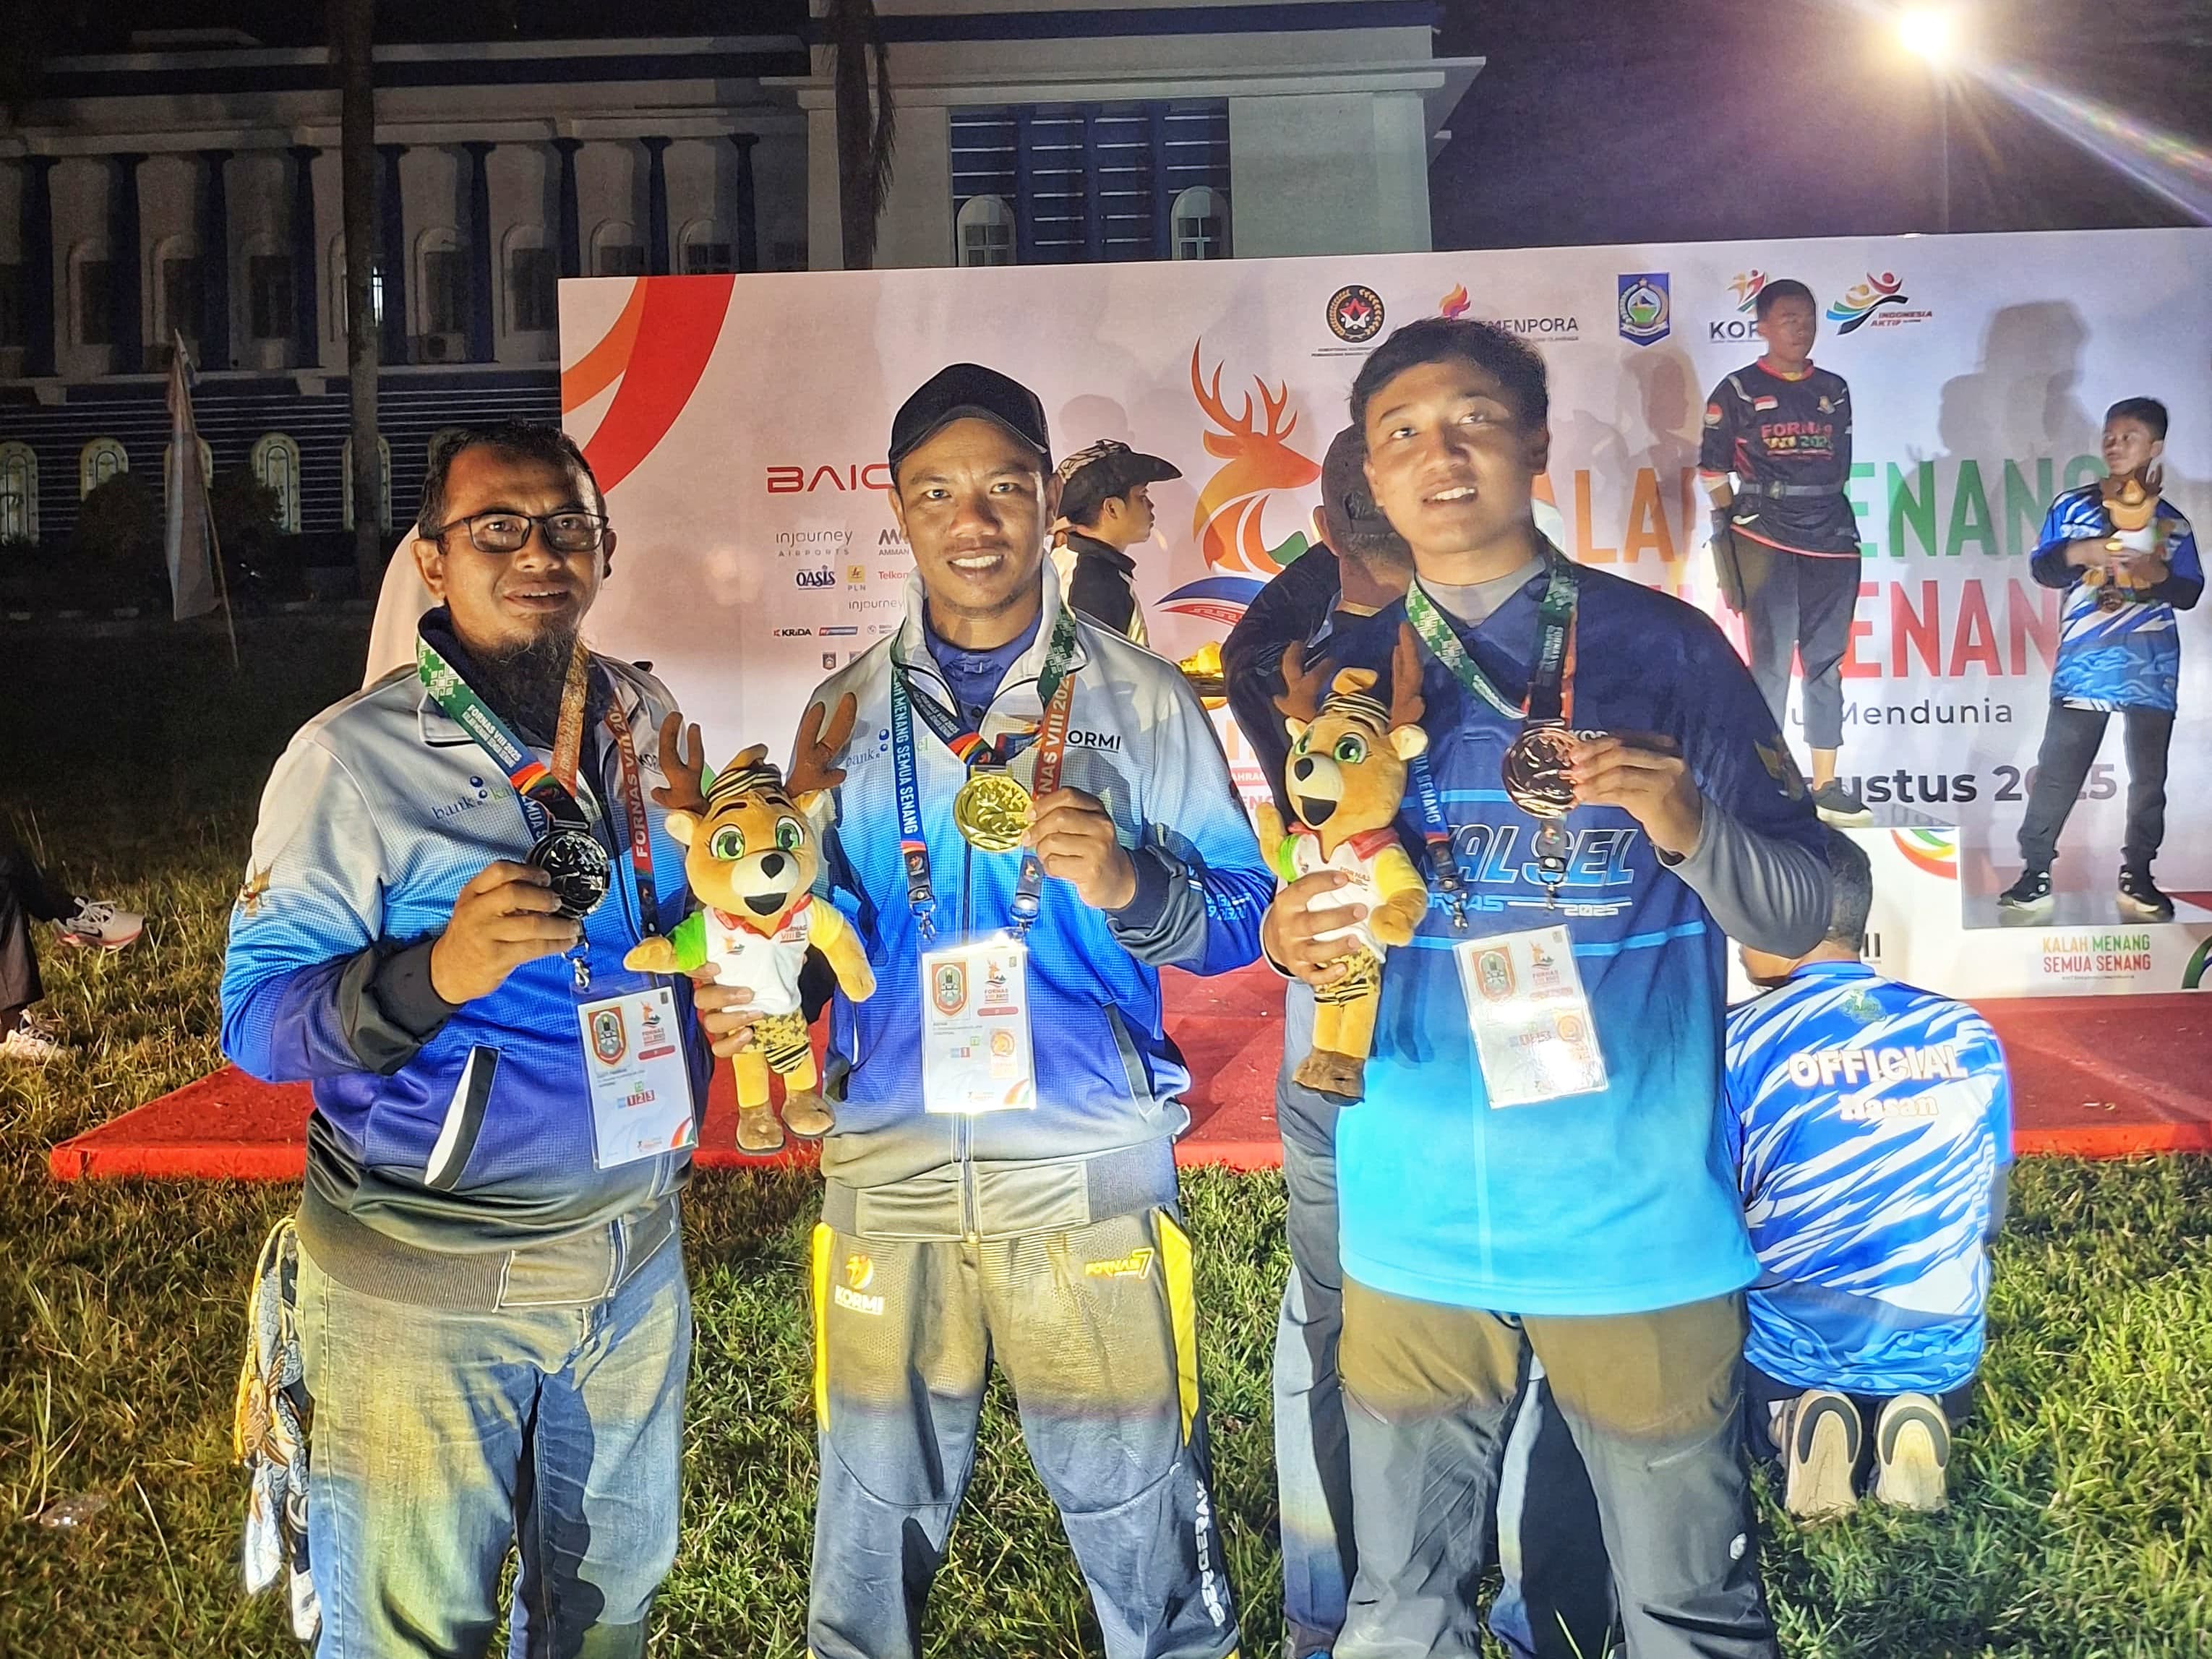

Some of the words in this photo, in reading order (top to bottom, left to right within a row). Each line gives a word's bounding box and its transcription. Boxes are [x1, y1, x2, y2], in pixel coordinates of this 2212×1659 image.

[766, 463, 895, 493] BAIC
[776, 530, 853, 548] injourney
[796, 565, 836, 587] OASIS
[1053, 676, 1070, 711] 202
[467, 704, 496, 734] FORNAS
[493, 729, 508, 747] VIII
[893, 697, 909, 745] MENANG
[1046, 713, 1064, 747] VIII
[1065, 730, 1122, 750] ORMI
[896, 745, 911, 786] SEMUA
[1037, 752, 1058, 792] NAS
[432, 797, 476, 820] bank
[627, 773, 648, 857] FORNAS
[899, 788, 918, 834] SENANG
[1564, 905, 1619, 917] 2025
[2043, 936, 2088, 953] KALAH
[2092, 934, 2151, 952] MENANG
[2044, 956, 2092, 973] SEMUA
[2096, 953, 2151, 972] SENANG
[1788, 1045, 1969, 1088] OFFICIAL
[835, 1285, 884, 1313] KORMI
